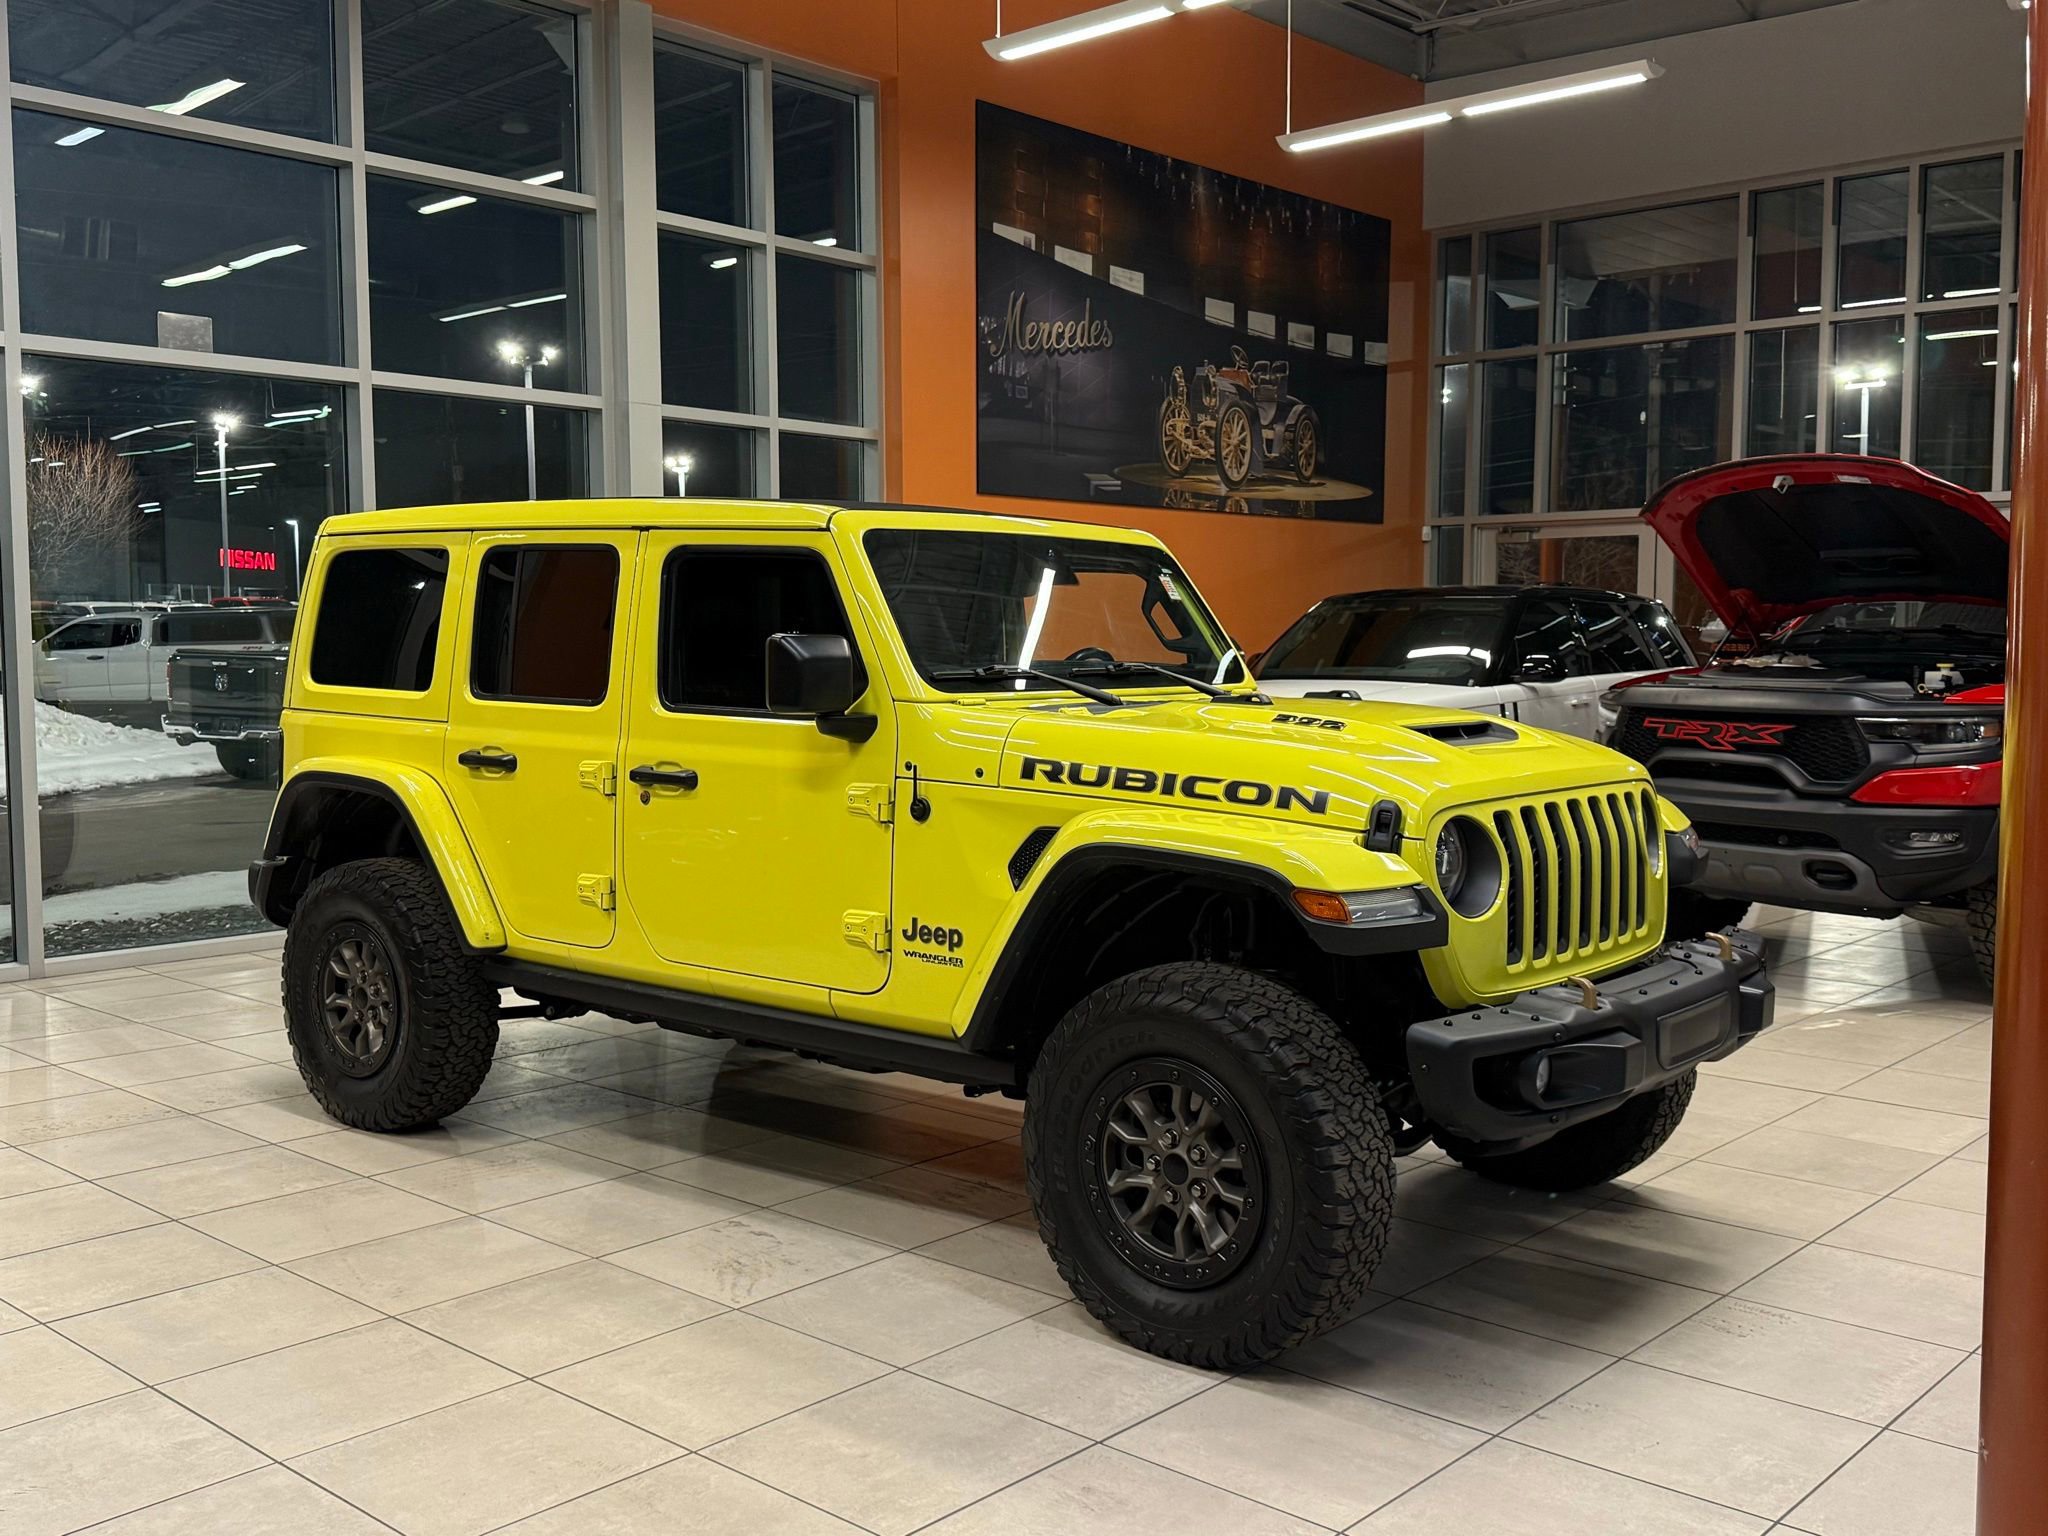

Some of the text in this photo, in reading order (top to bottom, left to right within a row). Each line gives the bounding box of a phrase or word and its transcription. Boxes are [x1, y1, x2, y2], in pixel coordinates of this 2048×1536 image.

[989, 289, 1113, 357] Mercedes
[1643, 718, 1796, 751] TRX
[1019, 756, 1331, 816] RUBICON
[901, 916, 964, 953] Jeep
[903, 949, 964, 964] WRANGLER
